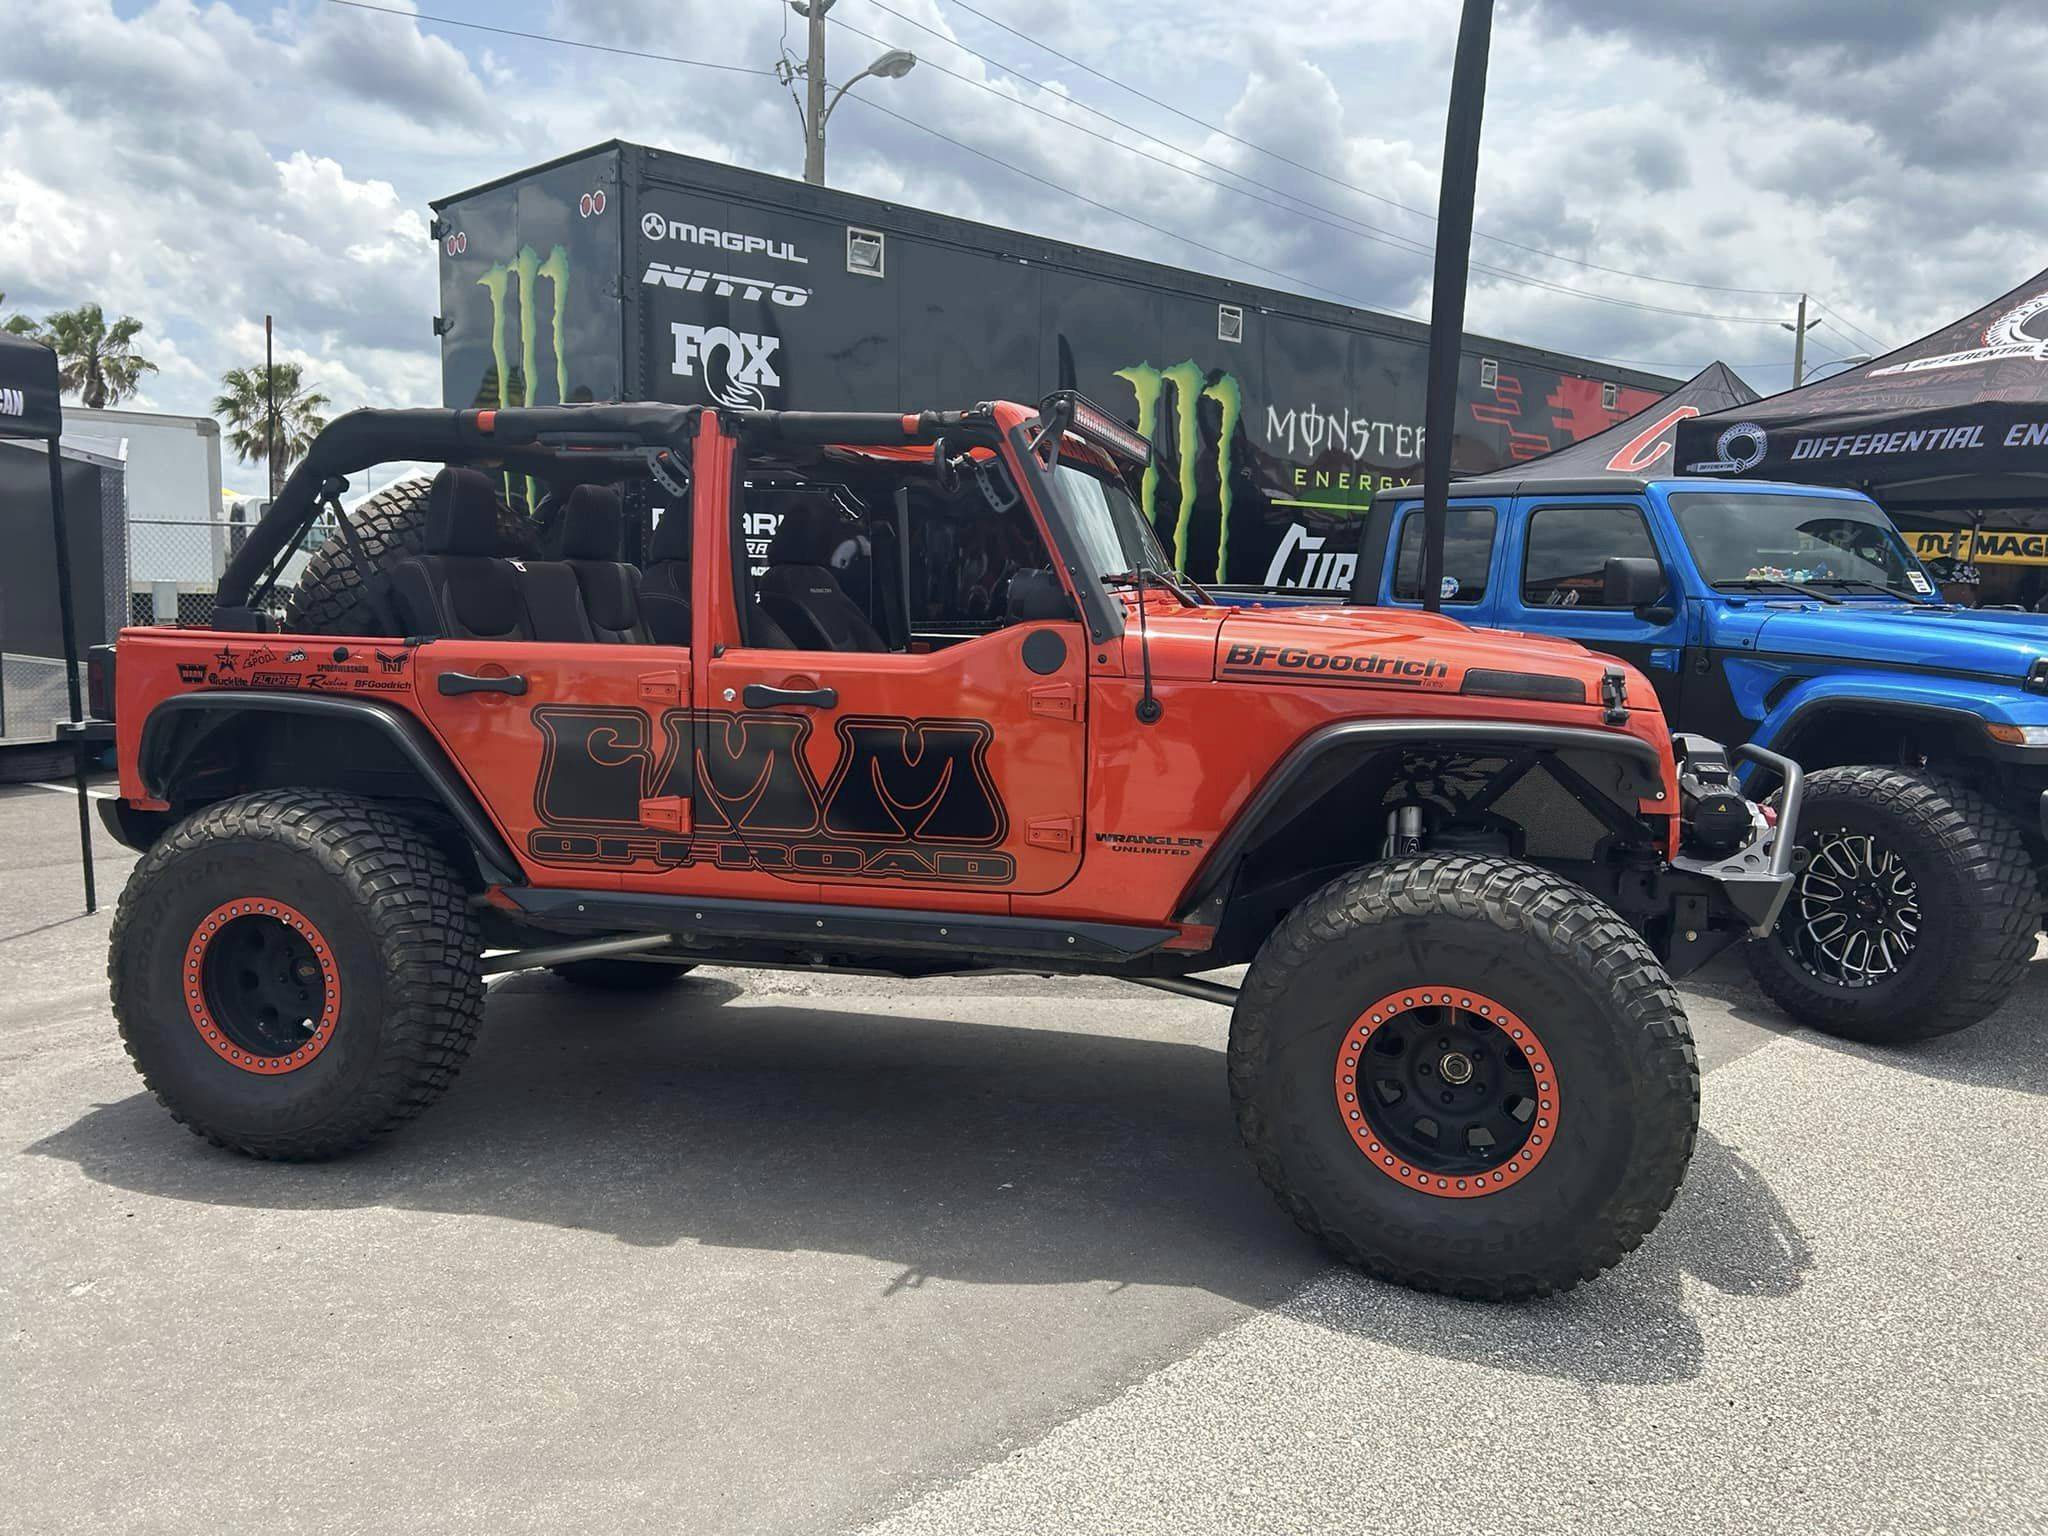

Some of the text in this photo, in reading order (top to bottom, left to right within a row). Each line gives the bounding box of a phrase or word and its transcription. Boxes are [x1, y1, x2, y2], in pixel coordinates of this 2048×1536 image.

[669, 220, 809, 264] MAGPUL
[642, 262, 809, 307] NITTO
[671, 322, 780, 388] FOX
[1791, 425, 1985, 461] DIFFERENTIAL
[1294, 468, 1411, 491] ENERGY
[1225, 644, 1448, 678] BFGoodrich
[354, 680, 411, 690] BFGoodrich
[1095, 832, 1204, 848] WRANGLER
[1112, 845, 1191, 856] UNLIMITED
